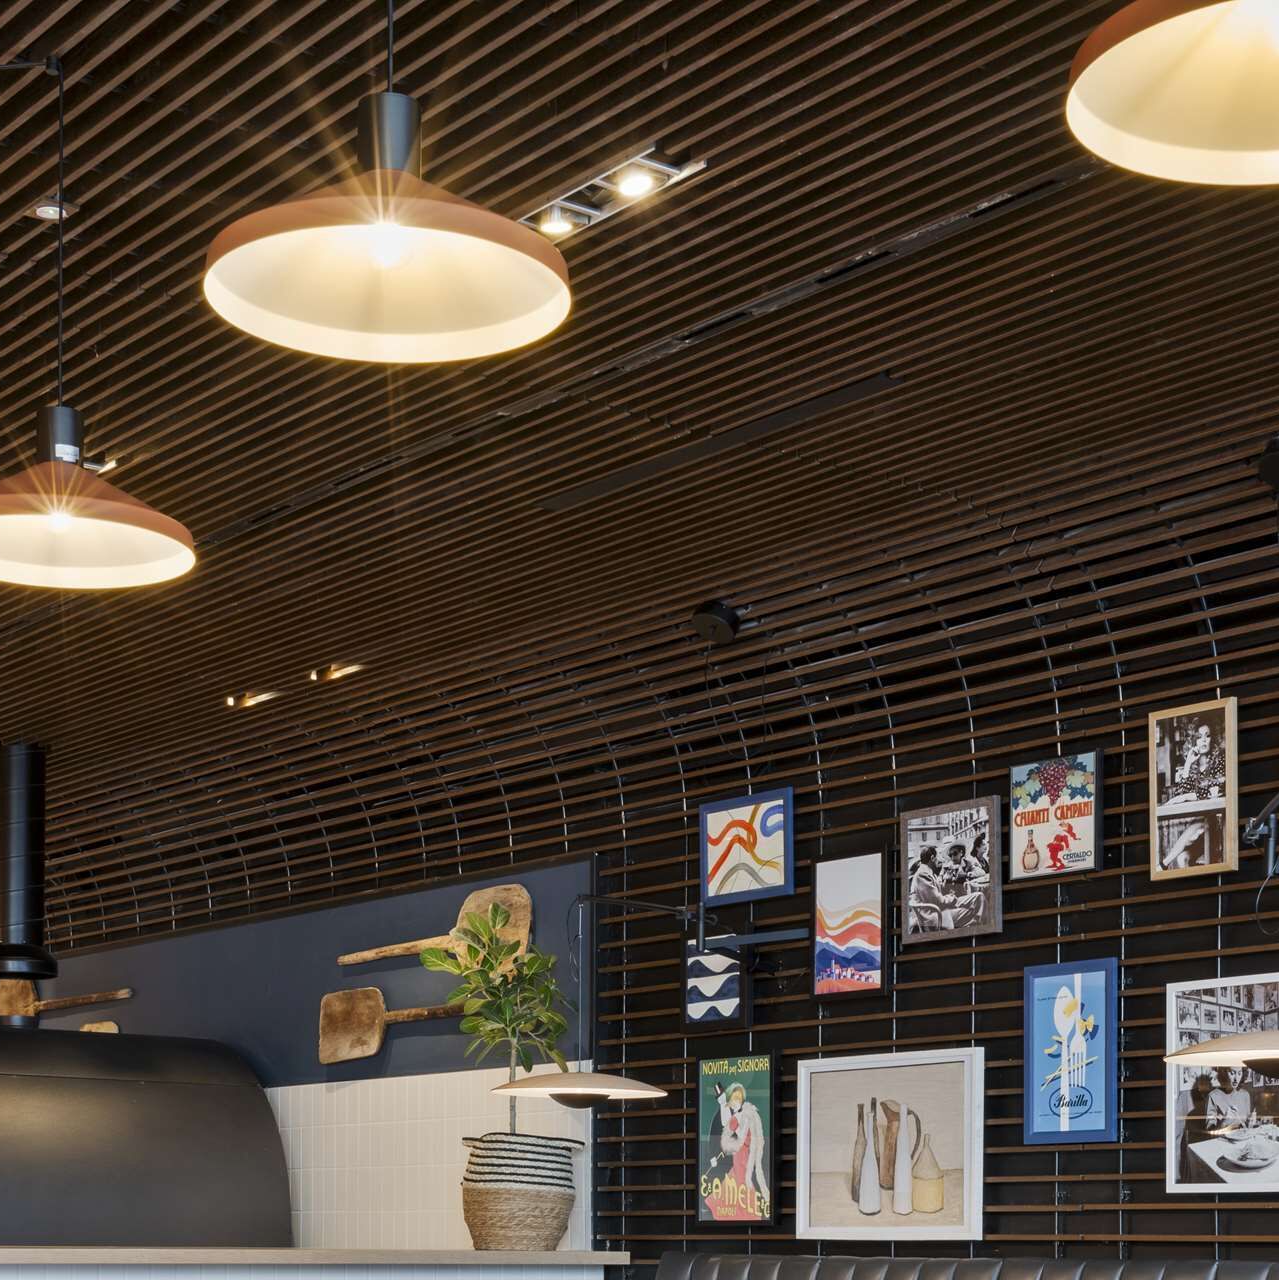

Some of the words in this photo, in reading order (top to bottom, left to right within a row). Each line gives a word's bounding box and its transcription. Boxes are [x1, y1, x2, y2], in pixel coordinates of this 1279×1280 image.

[1014, 808, 1050, 827] CHIANTI
[1054, 800, 1093, 820] CAMPANI
[738, 1058, 770, 1073] SIGNORA
[1053, 1094, 1089, 1109] Barilla
